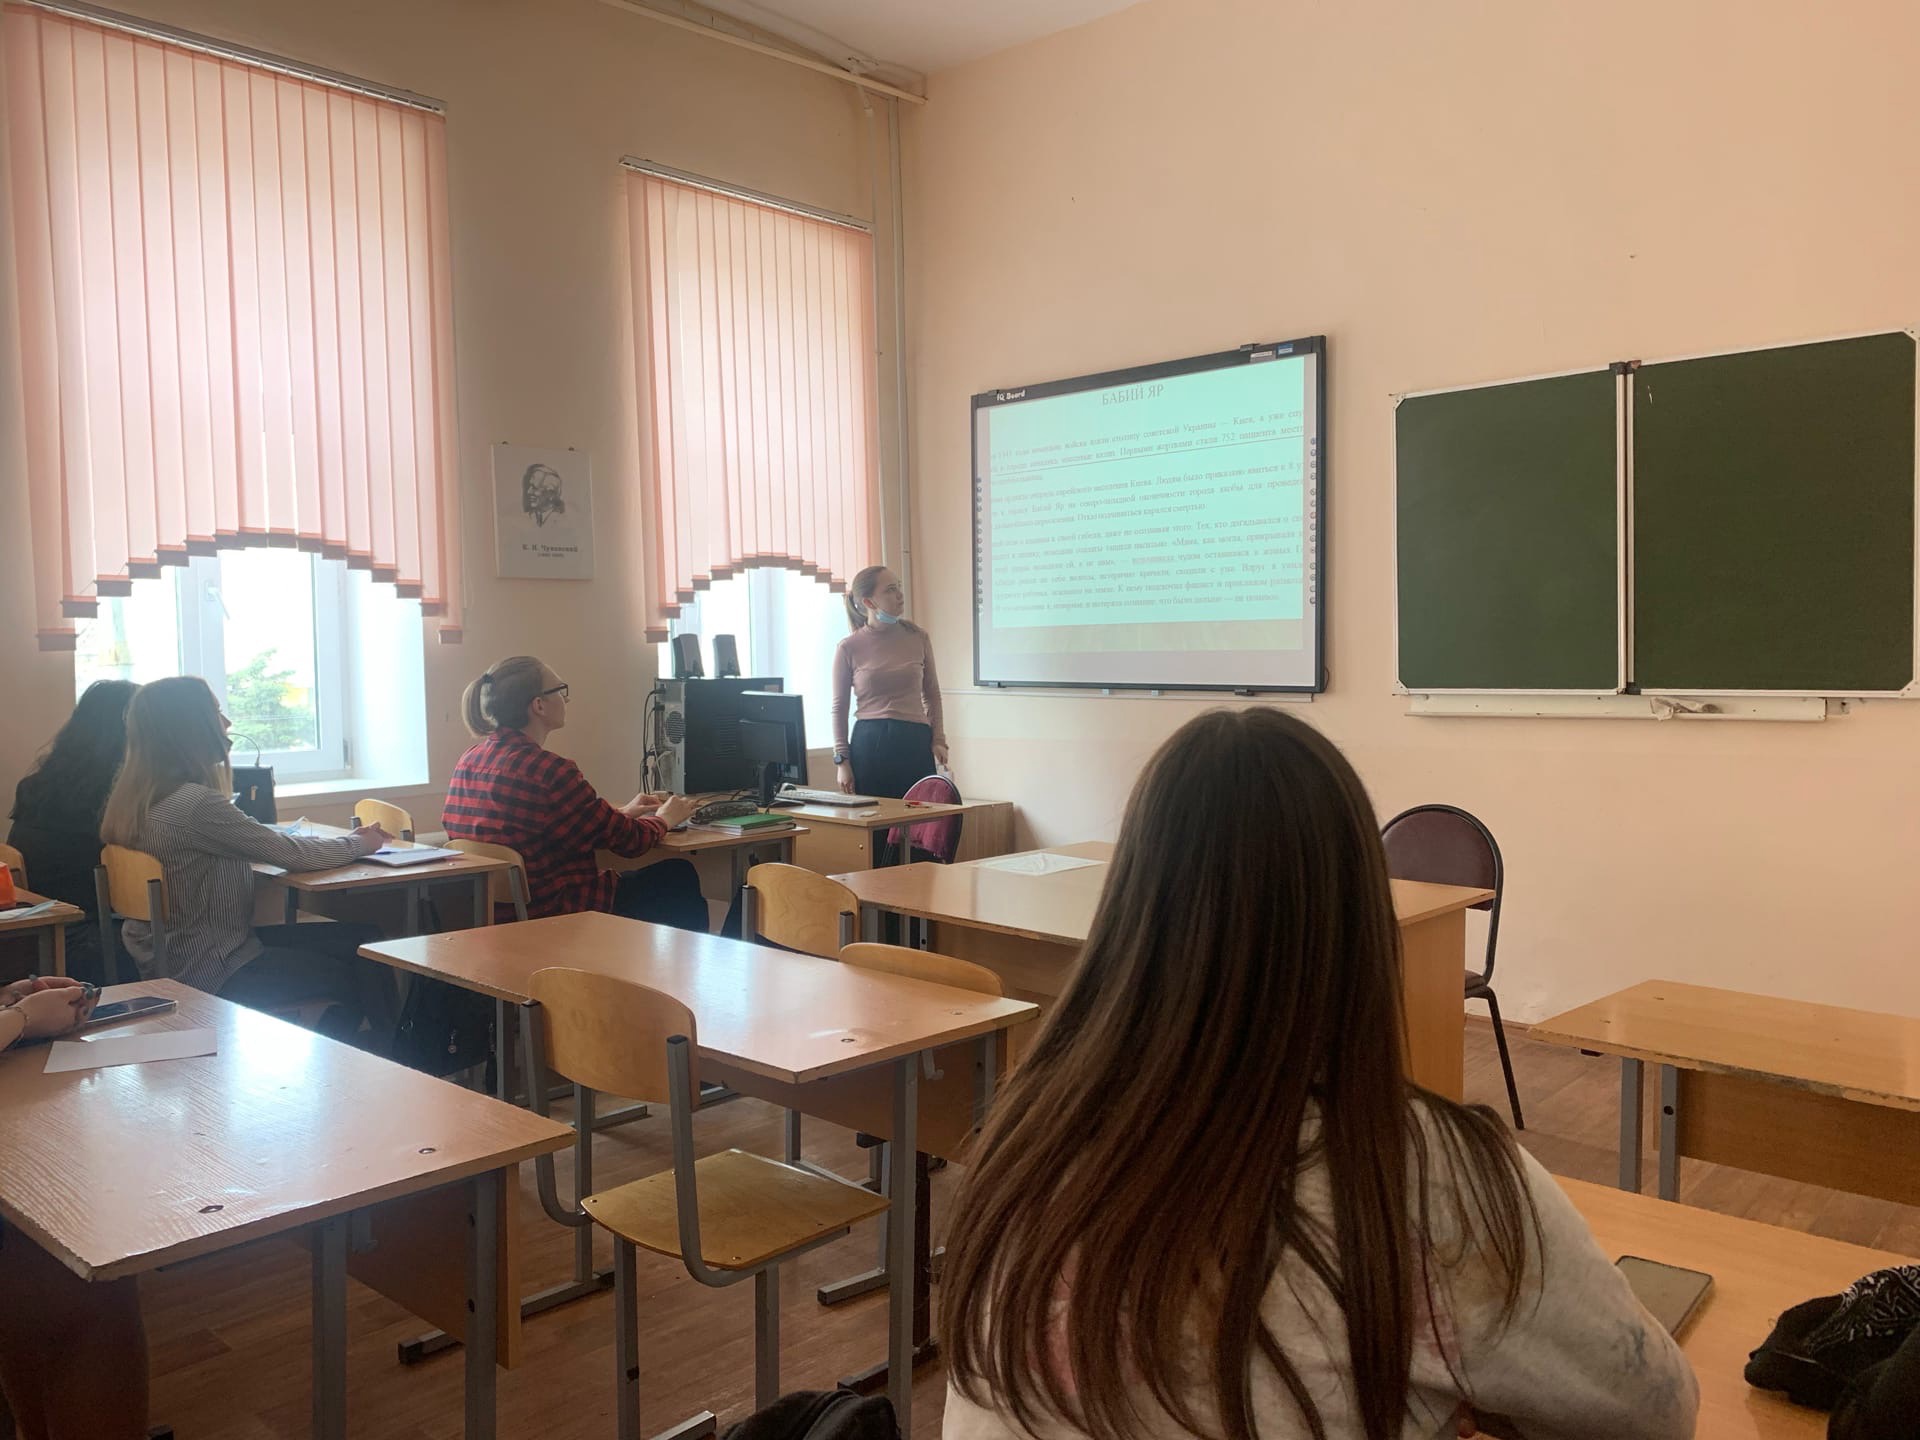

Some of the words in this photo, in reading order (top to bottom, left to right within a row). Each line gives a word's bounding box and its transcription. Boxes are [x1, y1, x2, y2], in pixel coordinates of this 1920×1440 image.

[996, 392, 1005, 401] IQ
[1006, 390, 1025, 400] Board
[1102, 384, 1144, 405] БАБИЙ
[1149, 384, 1164, 398] ЯР
